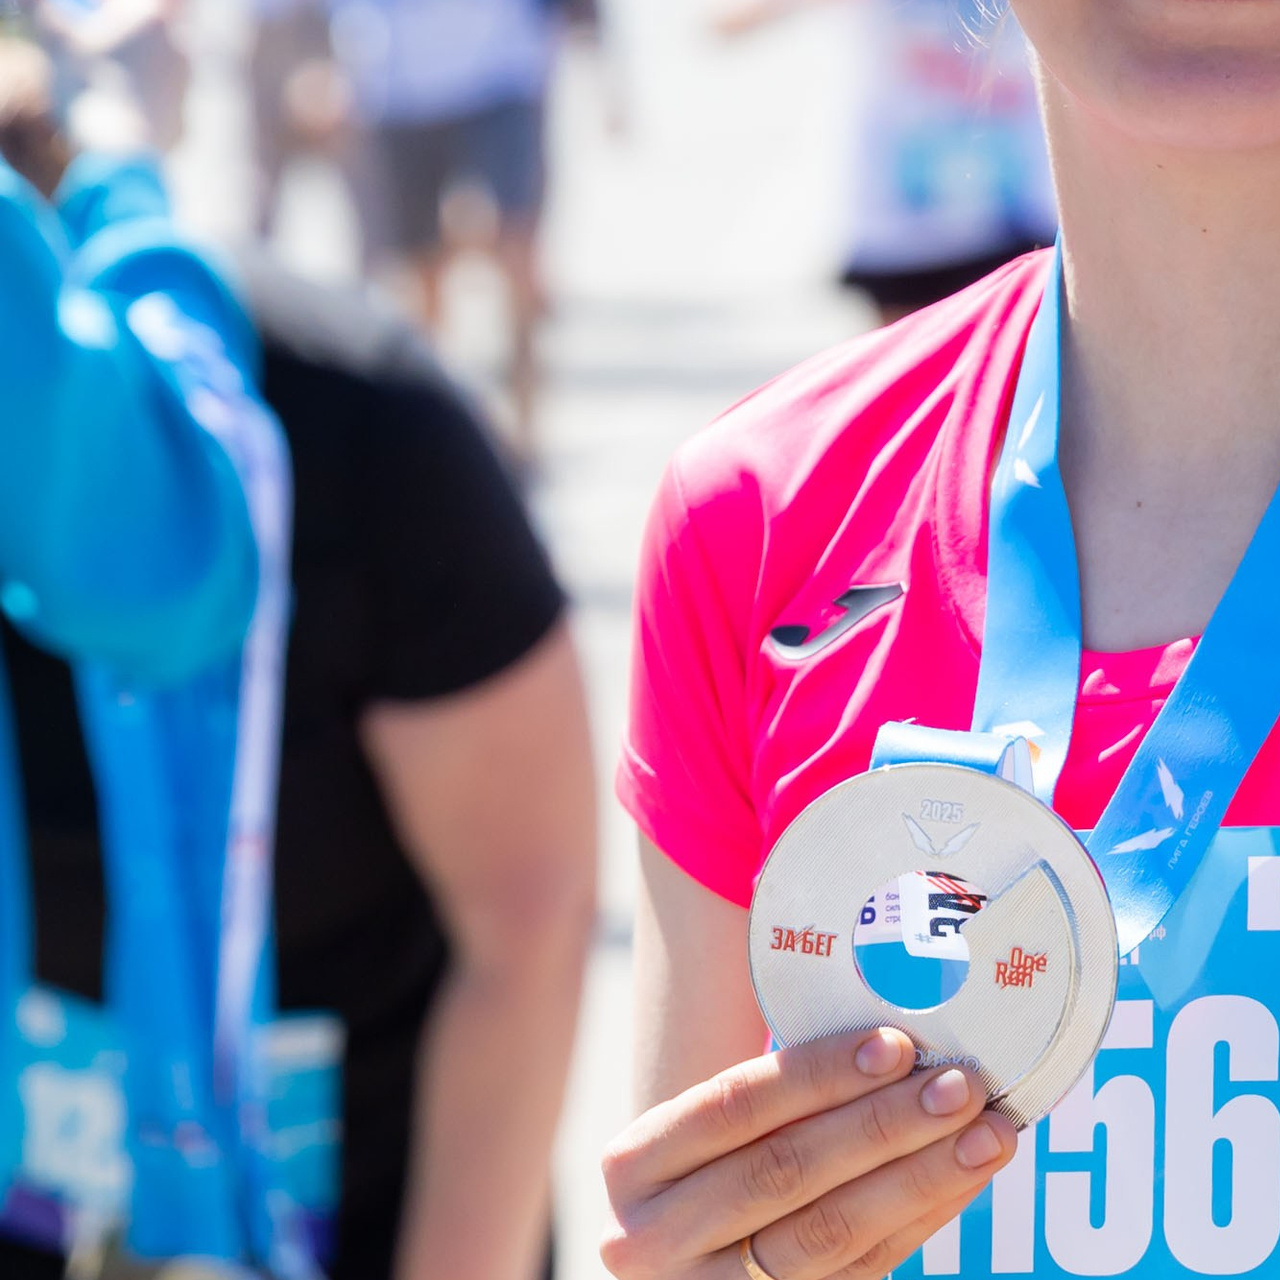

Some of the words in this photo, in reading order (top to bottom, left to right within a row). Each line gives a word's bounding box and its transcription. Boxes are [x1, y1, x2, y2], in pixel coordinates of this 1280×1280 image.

[921, 799, 964, 824] 2025
[1167, 836, 1190, 870] ЛИГА
[1185, 789, 1214, 838] ГЕРОЕВ
